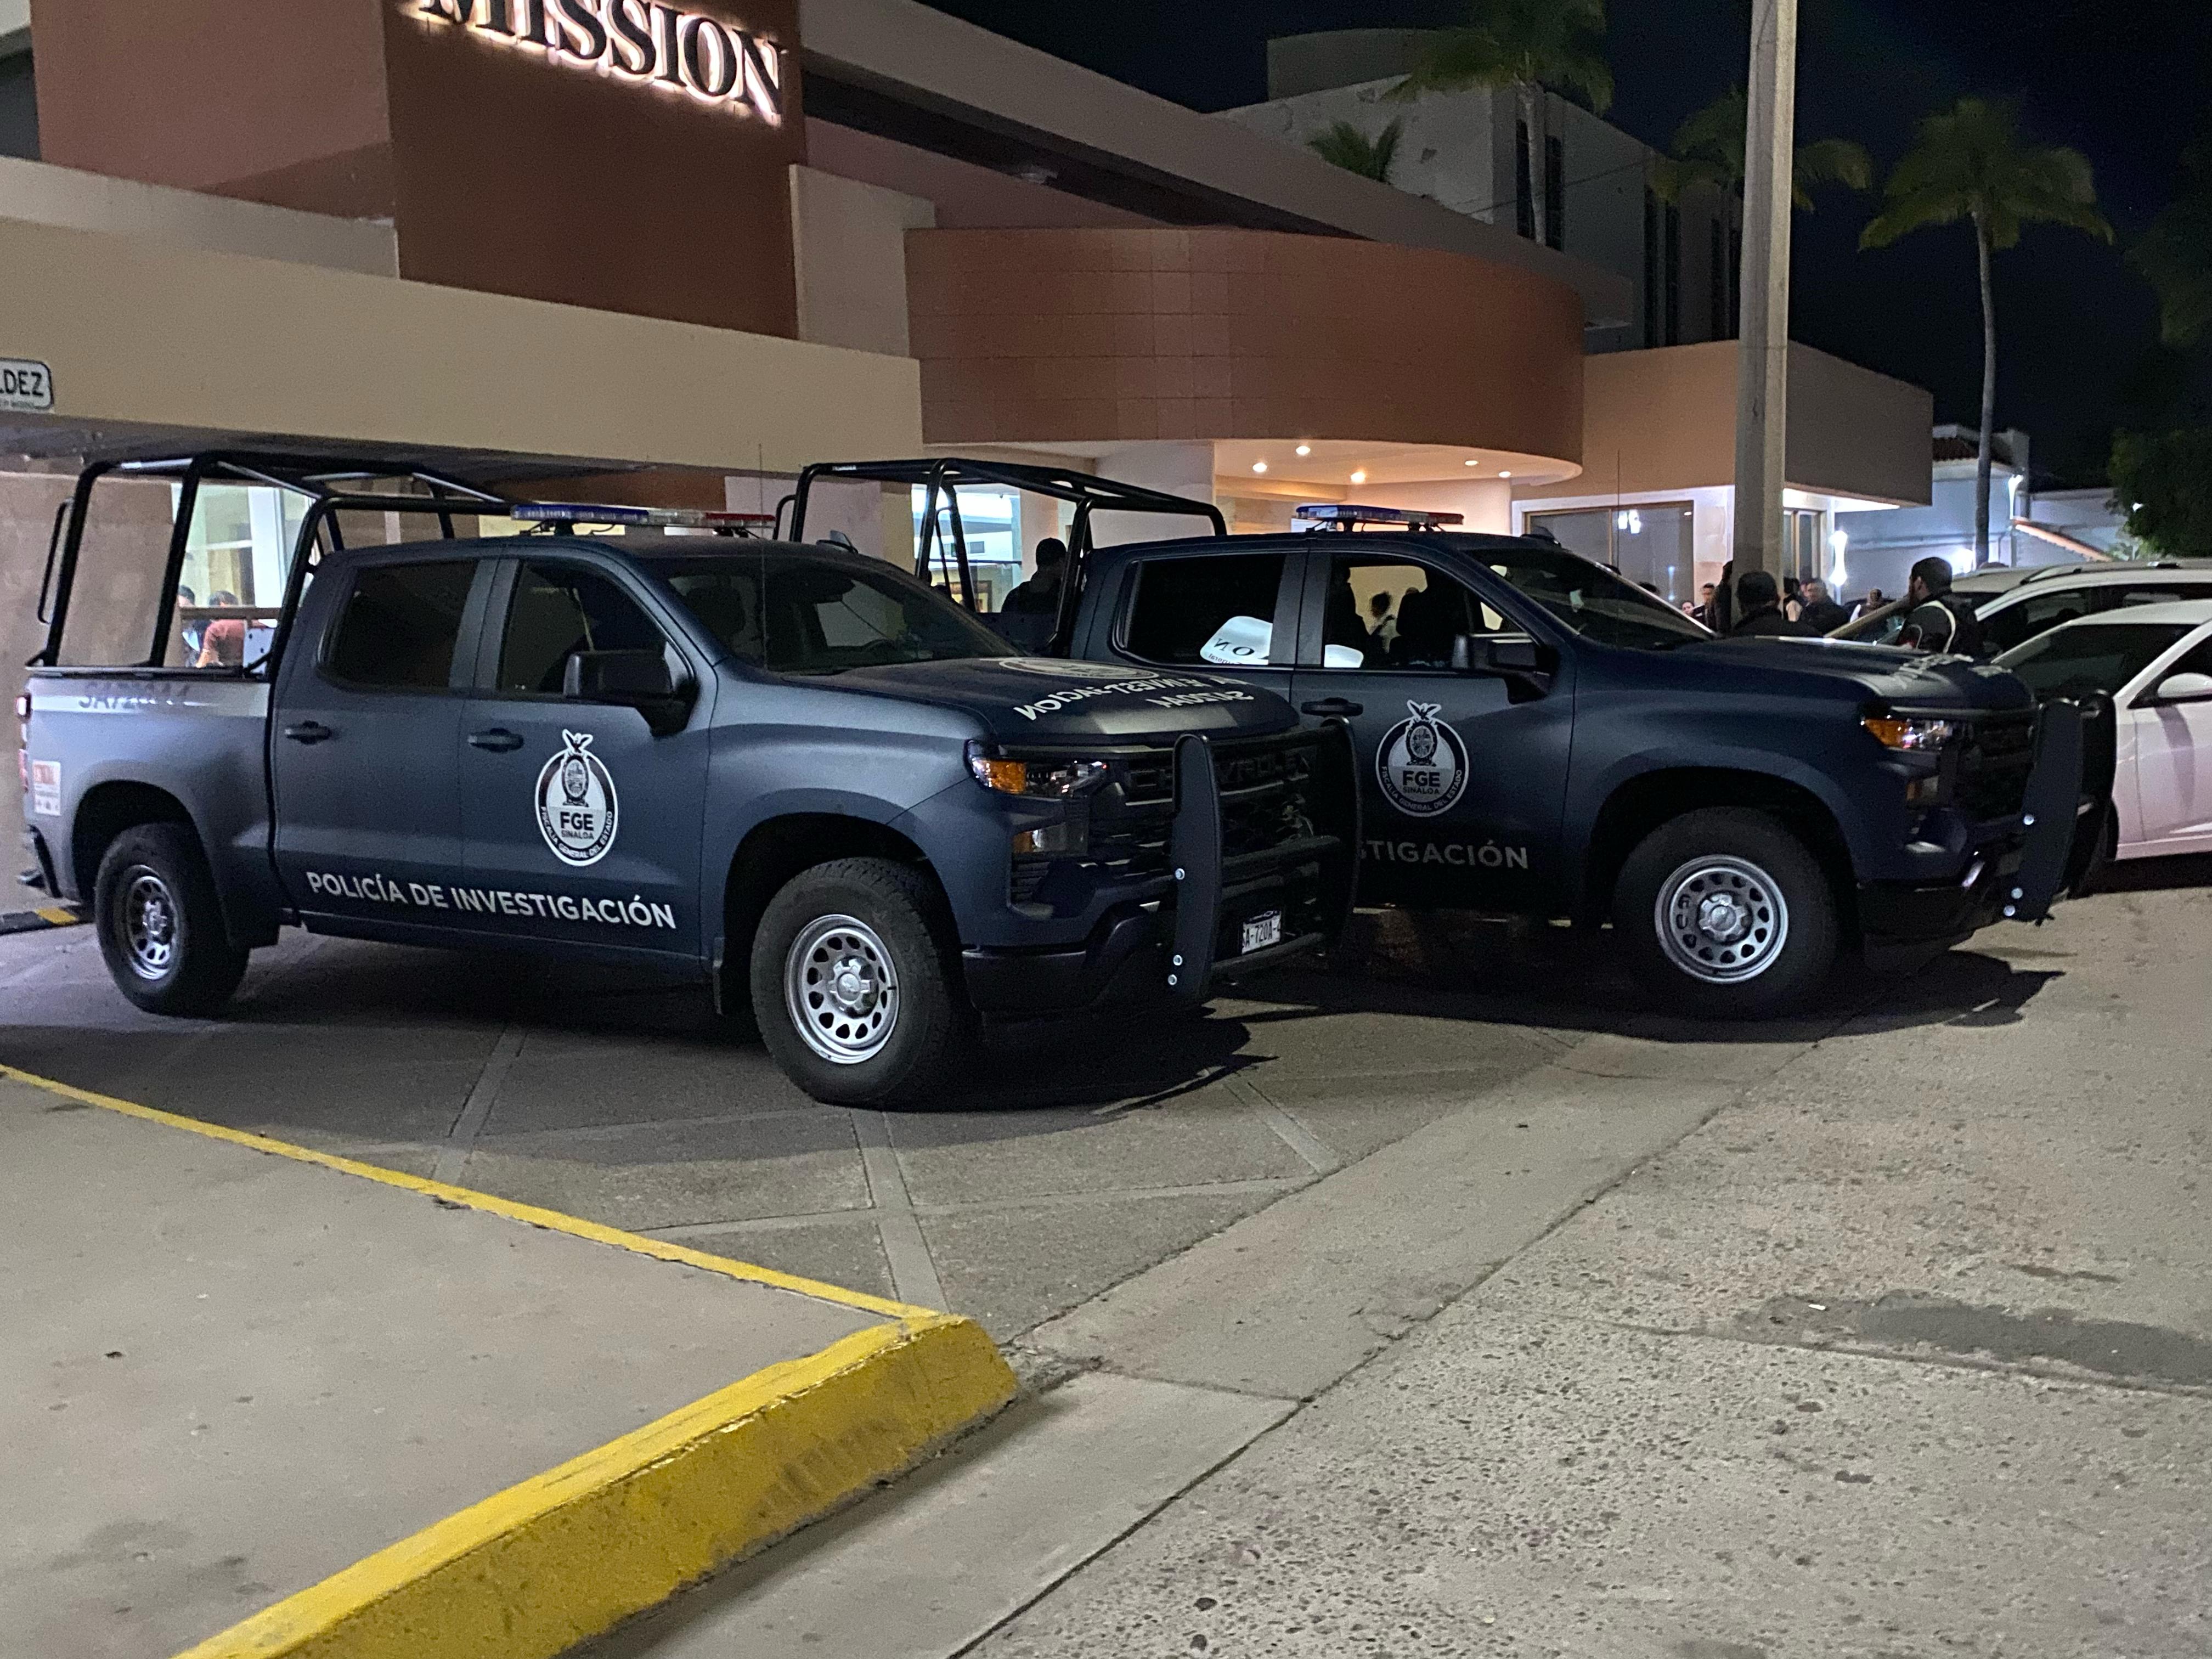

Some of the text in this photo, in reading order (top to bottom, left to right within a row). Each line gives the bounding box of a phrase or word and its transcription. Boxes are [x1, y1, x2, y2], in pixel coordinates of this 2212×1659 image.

[0, 369, 44, 398] DEZ
[1399, 797, 1432, 811] GENERAL
[1434, 798, 1448, 809] DEL
[1446, 769, 1463, 799] ESTADO
[1402, 786, 1440, 795] SINALOA
[1403, 770, 1440, 787] FGE
[558, 843, 589, 859] GENERAL
[589, 844, 602, 856] DEL
[600, 811, 613, 845] ESTADO
[560, 811, 594, 831] FGE
[561, 830, 595, 840] SINALOA
[1359, 839, 1529, 869] TIGACIÓN
[306, 871, 676, 929] POLICÍA DE INVESTIGACIÓN
